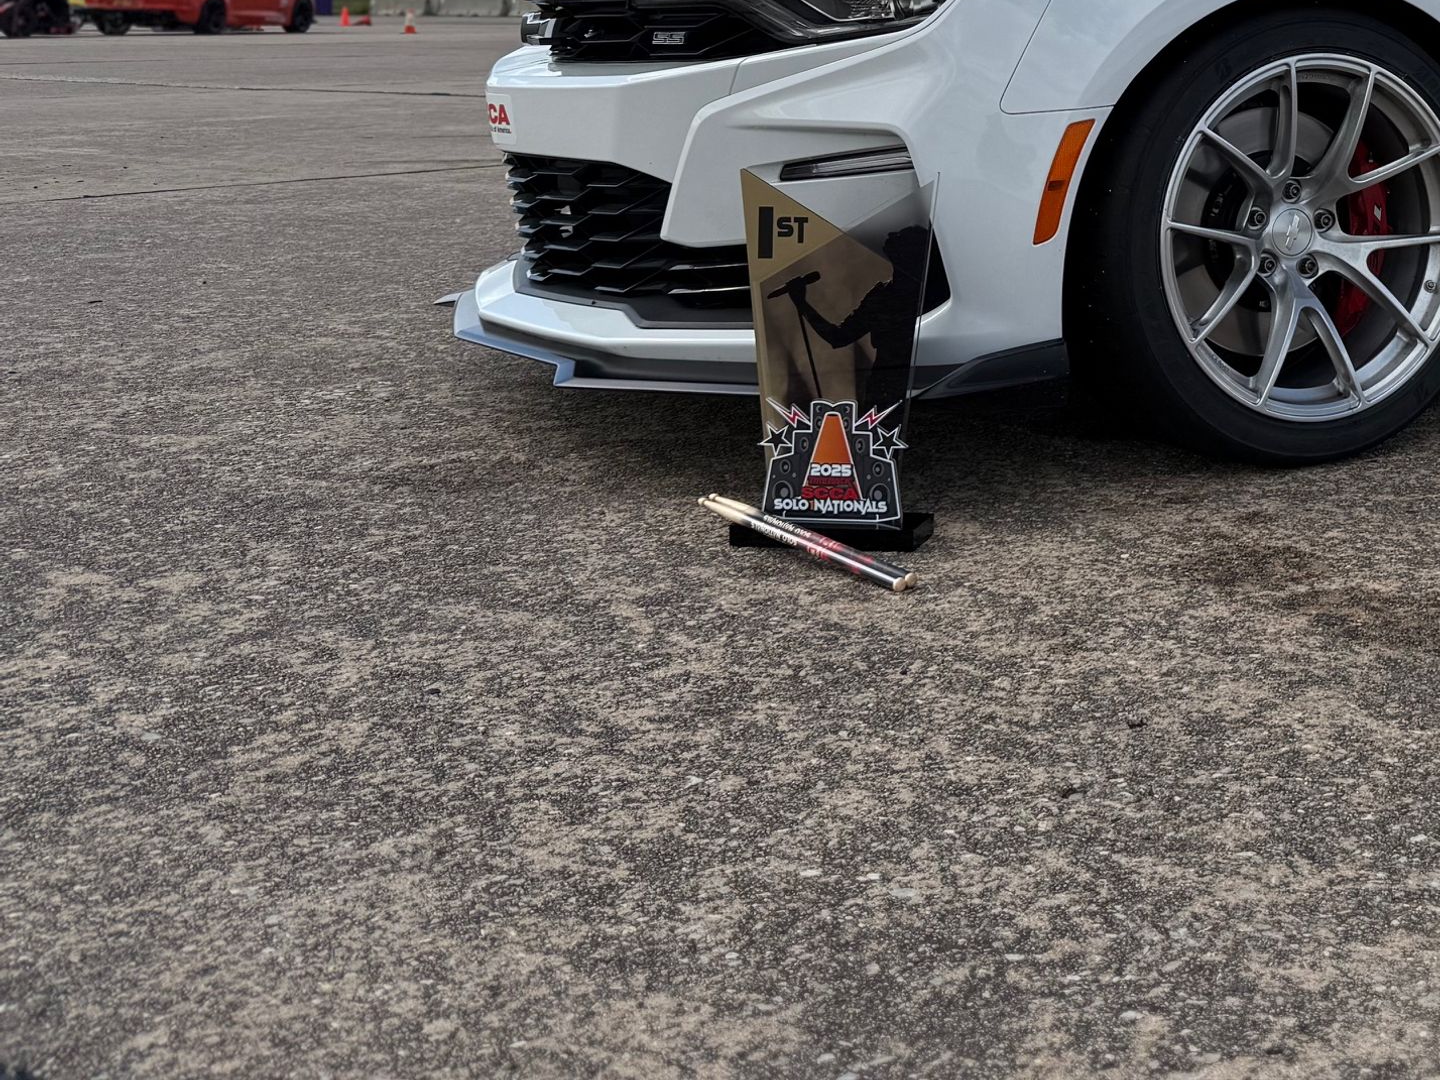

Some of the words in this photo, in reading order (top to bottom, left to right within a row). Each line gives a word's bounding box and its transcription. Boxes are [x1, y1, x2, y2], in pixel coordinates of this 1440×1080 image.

[652, 31, 686, 45] SS
[810, 463, 852, 476] 2025
[801, 486, 859, 500] SCCA
[773, 499, 809, 510] SOLO
[814, 497, 887, 515] NATIONALS
